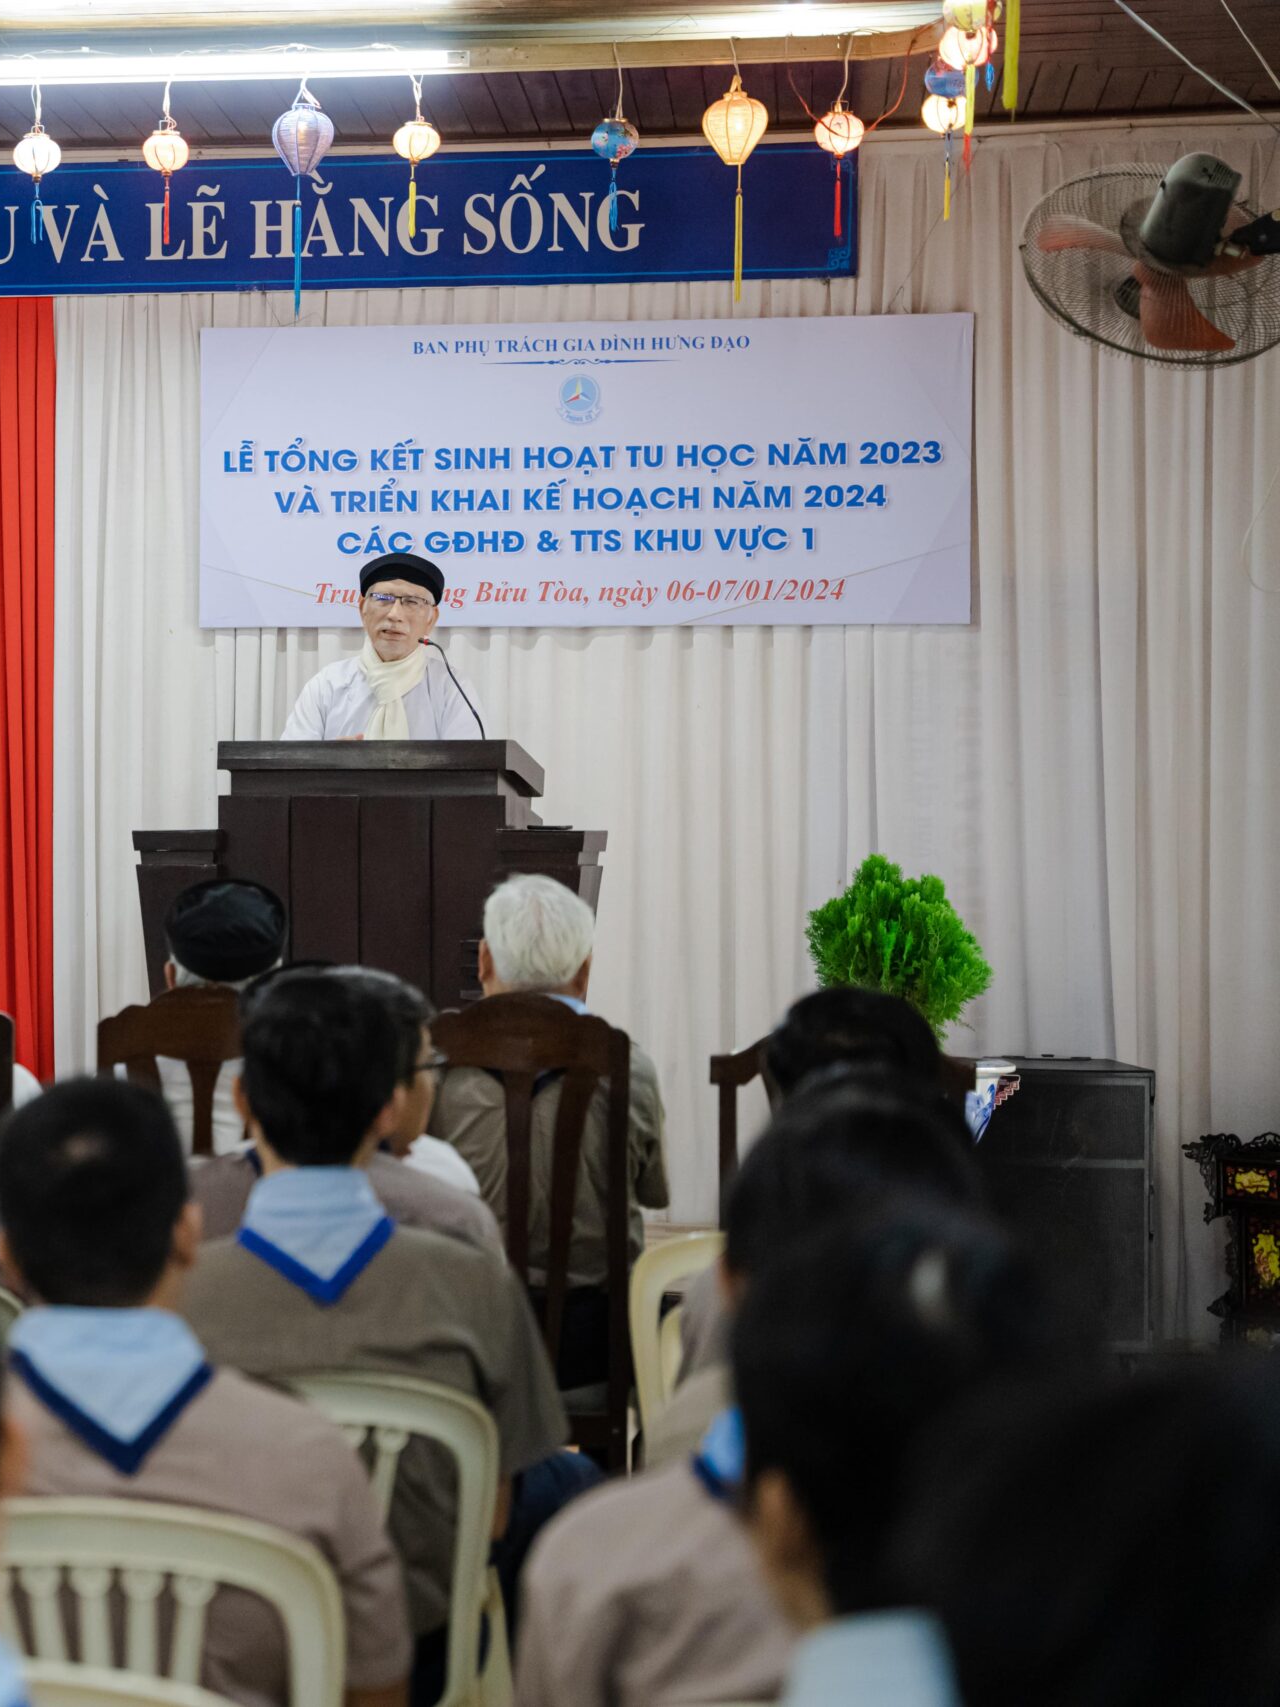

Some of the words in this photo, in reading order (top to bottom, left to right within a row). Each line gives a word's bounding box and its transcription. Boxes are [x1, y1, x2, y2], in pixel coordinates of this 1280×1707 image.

[40, 184, 124, 264] VÀ
[145, 184, 227, 260] LẼ
[250, 168, 444, 258] HẰNG
[463, 163, 645, 255] SỐNG
[413, 341, 449, 355] BAN
[455, 339, 490, 357] PHỤ
[495, 335, 558, 353] TRÁCH
[563, 337, 596, 352] GIA
[600, 333, 645, 351] ĐÌNH
[651, 334, 705, 351] HƯNG
[711, 335, 751, 352] ĐẠO
[223, 440, 255, 473] LỄ
[264, 437, 359, 472] TỔNG
[370, 439, 425, 470] KẾT
[434, 448, 511, 470] SINH
[523, 445, 615, 475] HOẠT
[626, 445, 663, 467] TU
[677, 444, 756, 474] HỌC
[768, 437, 847, 466] NĂM
[859, 441, 942, 465] 2023
[274, 485, 320, 513] VÀ
[331, 478, 418, 512] TRIỂN
[431, 489, 510, 512] KHAI
[524, 479, 567, 510] KẾ
[573, 486, 700, 516] HOẠCH
[713, 480, 791, 508] NĂM
[804, 484, 887, 507] 2024
[337, 526, 413, 554] CÁC
[424, 531, 524, 553] GĐHĐ
[537, 530, 559, 552] &
[570, 529, 622, 552] TTS
[634, 529, 702, 551] KHU
[714, 525, 787, 558] VỰC
[802, 528, 814, 550] 1
[475, 580, 530, 603] Bửu
[538, 581, 590, 605] Tòa,
[598, 580, 658, 607] ngày
[666, 579, 846, 602] 06-07/01/2024
